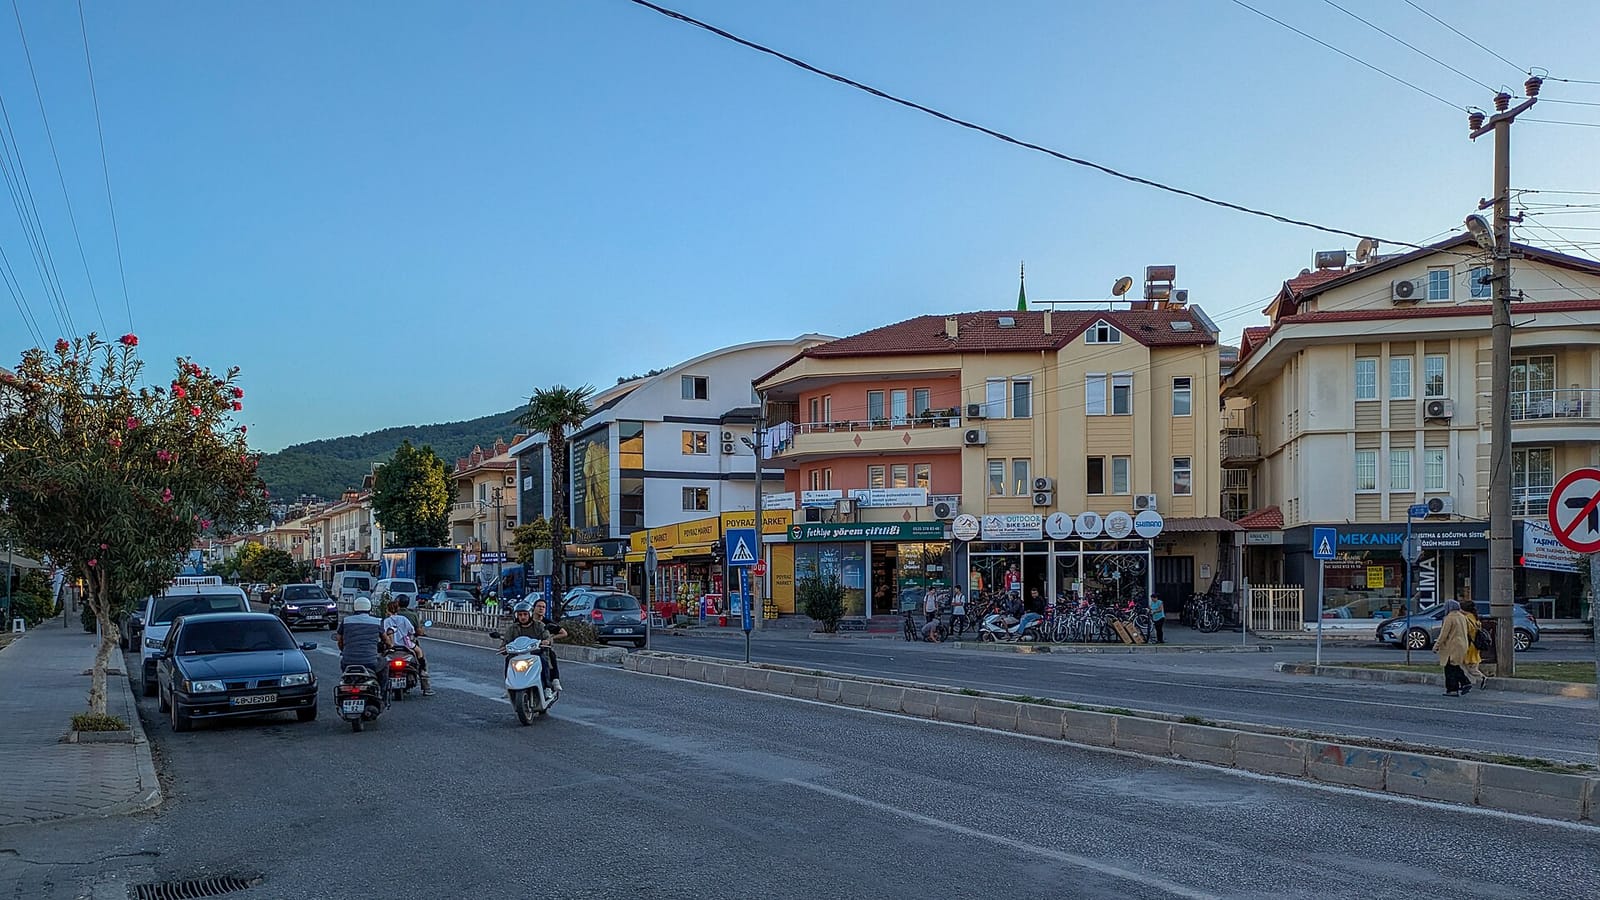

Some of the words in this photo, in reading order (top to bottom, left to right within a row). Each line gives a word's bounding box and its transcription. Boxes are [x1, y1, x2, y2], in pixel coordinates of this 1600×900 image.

[726, 519, 755, 527] POYRAZ
[763, 518, 787, 526] ARKET
[806, 527, 830, 538] fethiye
[832, 528, 862, 538] yörem
[865, 525, 900, 537] çiftliği
[1416, 557, 1436, 611] KLİMA
